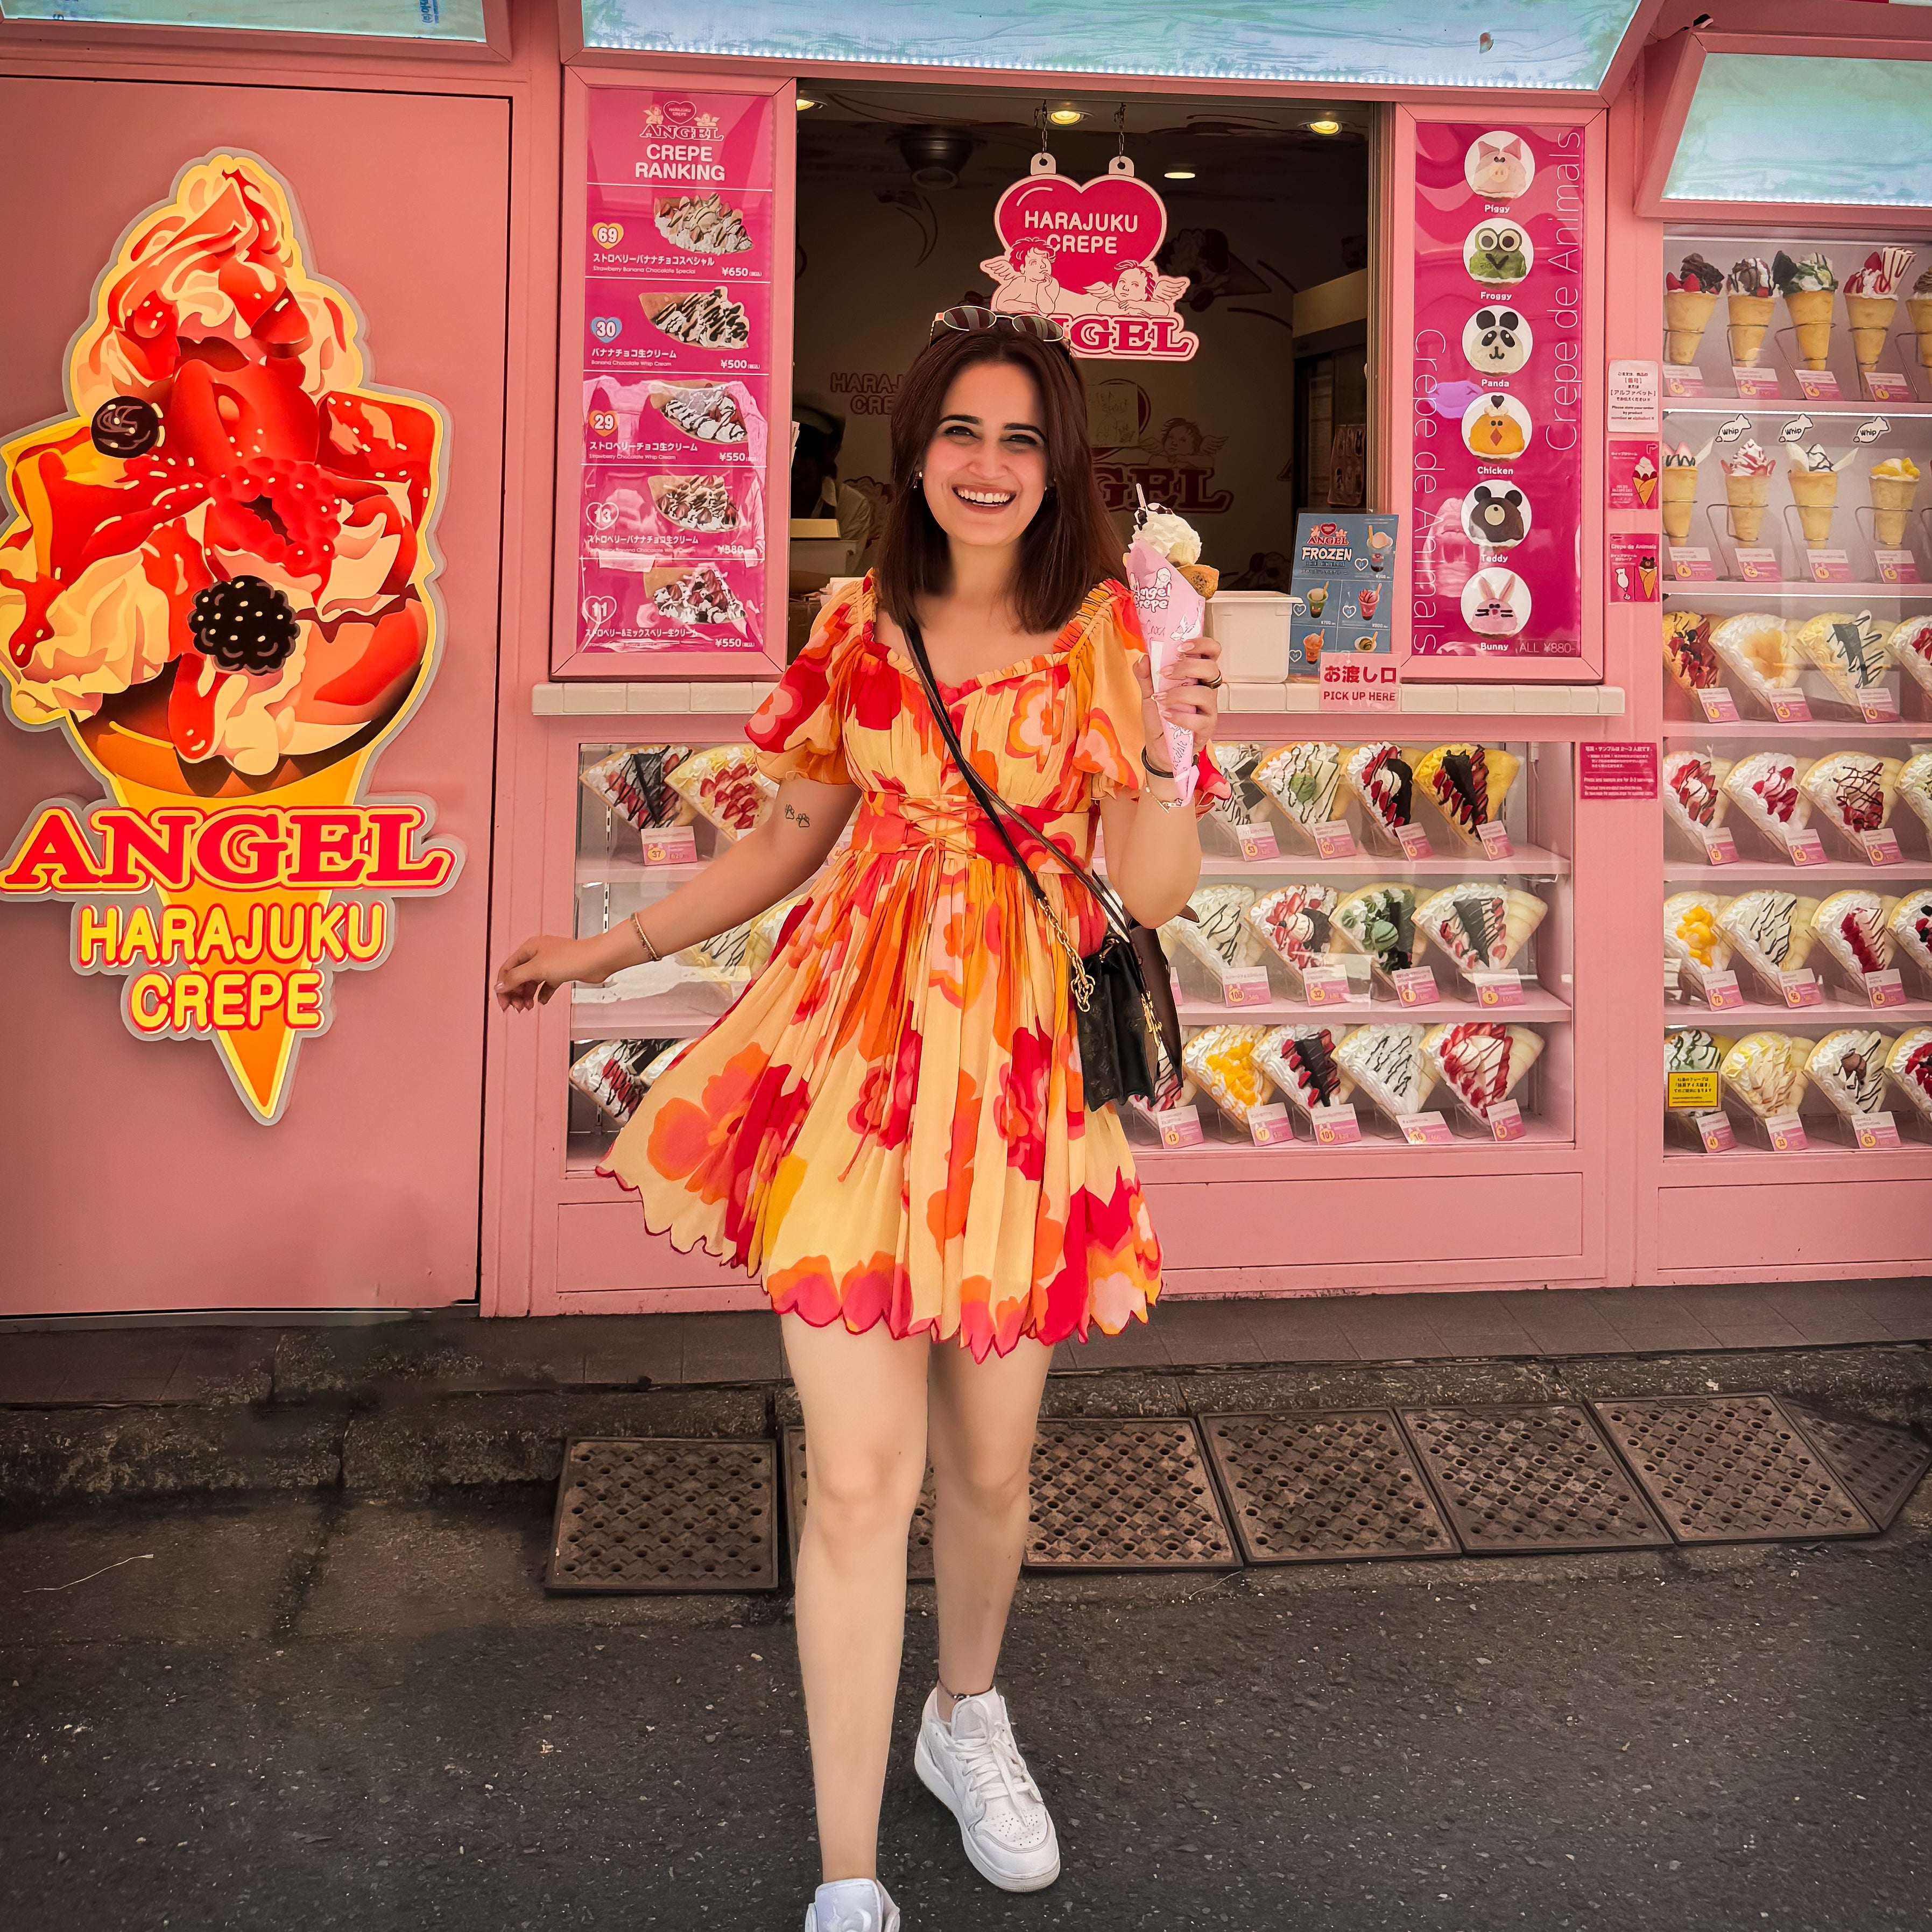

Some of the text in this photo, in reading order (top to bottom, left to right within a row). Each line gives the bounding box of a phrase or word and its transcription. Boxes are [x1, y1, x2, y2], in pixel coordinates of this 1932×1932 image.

[639, 124, 724, 141] ANGEL
[646, 144, 713, 161] CREPE
[635, 162, 725, 181] RANKING
[1484, 205, 1510, 213] Piggy
[1025, 210, 1138, 232] HARAJUKU
[598, 227, 618, 243] 69
[1046, 234, 1117, 254] CREPE
[593, 253, 715, 266] ストロベリーバナナチョコスペシャル
[1480, 292, 1512, 301] Froggy
[1546, 132, 1582, 450] Crepe de Animals
[596, 322, 616, 337] 30
[1052, 316, 1196, 354] GEL
[591, 348, 677, 358] バナナチョコ生クリーム
[830, 372, 904, 393] HARAJ
[1481, 379, 1510, 387] Panda
[850, 394, 896, 415] CRE
[595, 415, 614, 429] 29
[589, 441, 698, 452] ストロベリーチョコ生クリーム
[720, 452, 746, 462] ¥550
[1477, 466, 1514, 475] Chicken
[1413, 329, 1447, 653] Crepe de Animals
[594, 507, 611, 523] 13
[1307, 537, 1350, 546] ANGEL
[1302, 546, 1352, 561] FROZEN
[1480, 554, 1508, 563] Teddy
[592, 602, 607, 617] 11
[715, 638, 742, 647] ¥550
[1480, 643, 1509, 652] Bunny
[1519, 643, 1540, 653] ALL
[1324, 665, 1397, 684] お渡し口
[1323, 691, 1395, 701] PICK UP HERE
[2, 807, 456, 891] ANGEL
[77, 902, 389, 968] HARAJUKU
[129, 970, 324, 1033] CREPE
[1169, 1133, 1176, 1141] 13
[1259, 1130, 1266, 1138] 17
[1322, 1130, 1333, 1139] 101
